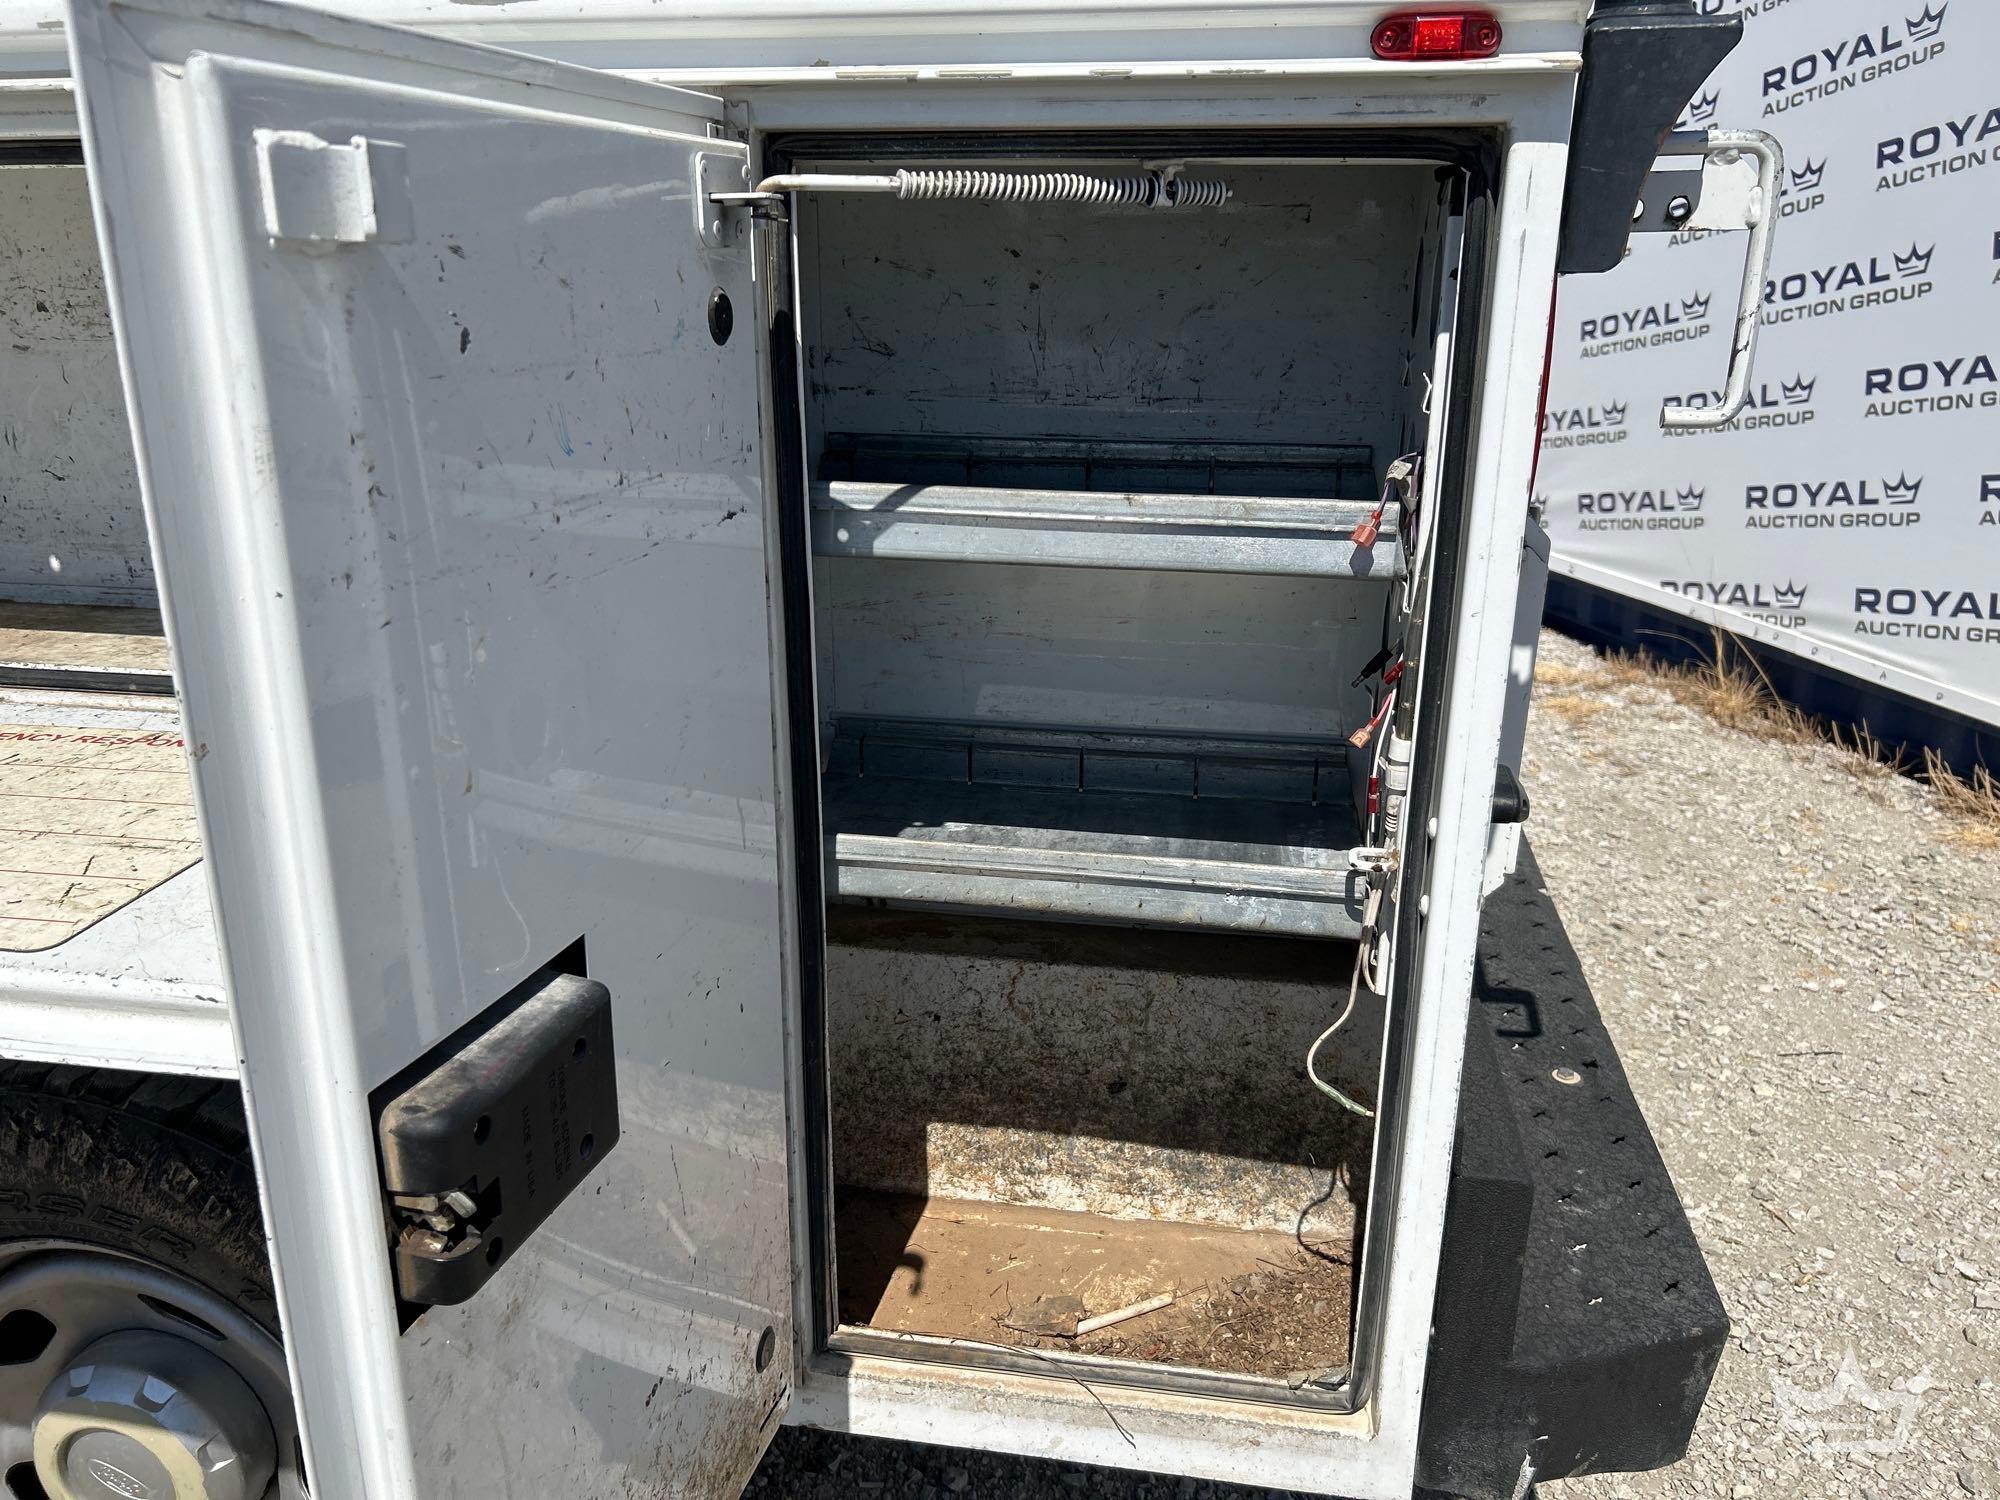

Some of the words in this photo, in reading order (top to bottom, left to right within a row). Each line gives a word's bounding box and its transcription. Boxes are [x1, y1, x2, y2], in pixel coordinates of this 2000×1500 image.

[1762, 25, 1903, 97] ROYAL
[1761, 72, 1856, 118] AUCTION
[1861, 41, 1945, 83] GROUP
[1875, 149, 1986, 192] AUCTION
[1760, 297, 1845, 325] UCTION
[1850, 281, 1932, 310] GROUP
[1580, 303, 1680, 342] ROYAL
[1580, 336, 1647, 359] AUCTION
[1650, 324, 1710, 347] GROUP
[1864, 393, 1974, 418] AUCTION
[1744, 410, 1815, 431] GROUP
[1576, 429, 1627, 446] GROUP
[1577, 489, 1675, 514] ROYAL
[1745, 480, 1880, 509] ROYAL
[1578, 517, 1644, 531] AUCTION
[1646, 515, 1705, 530] GROUP
[1745, 513, 1835, 529] AUCTION
[1840, 511, 1921, 527] GROUP
[1854, 619, 1961, 641] AUCTION
